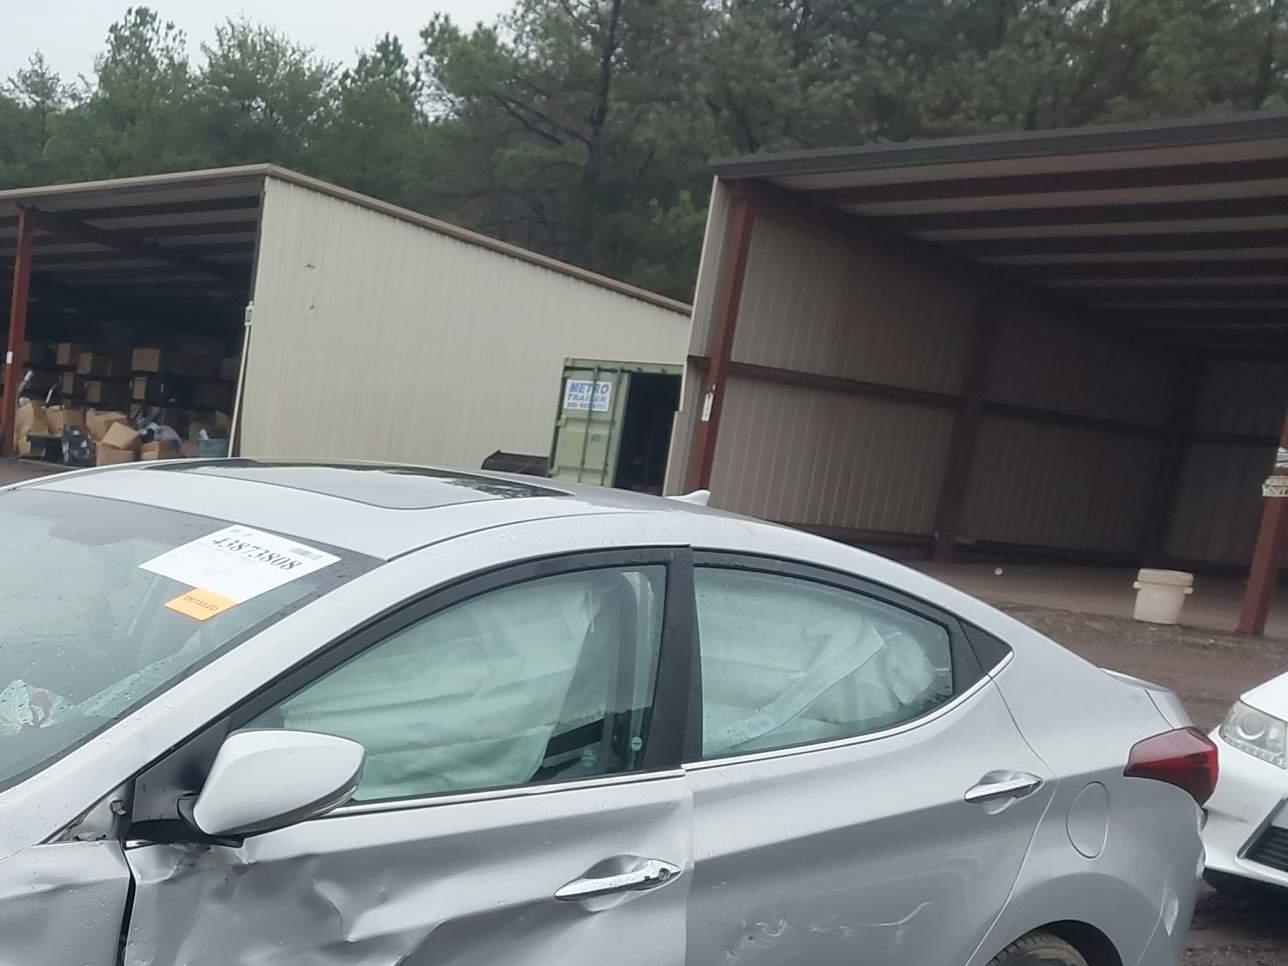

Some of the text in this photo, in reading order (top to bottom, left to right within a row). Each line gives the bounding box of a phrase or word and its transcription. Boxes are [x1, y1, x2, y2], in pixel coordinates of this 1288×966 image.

[569, 382, 609, 394] METRO
[567, 393, 607, 402] TRAIER
[212, 537, 302, 570] 43873808
